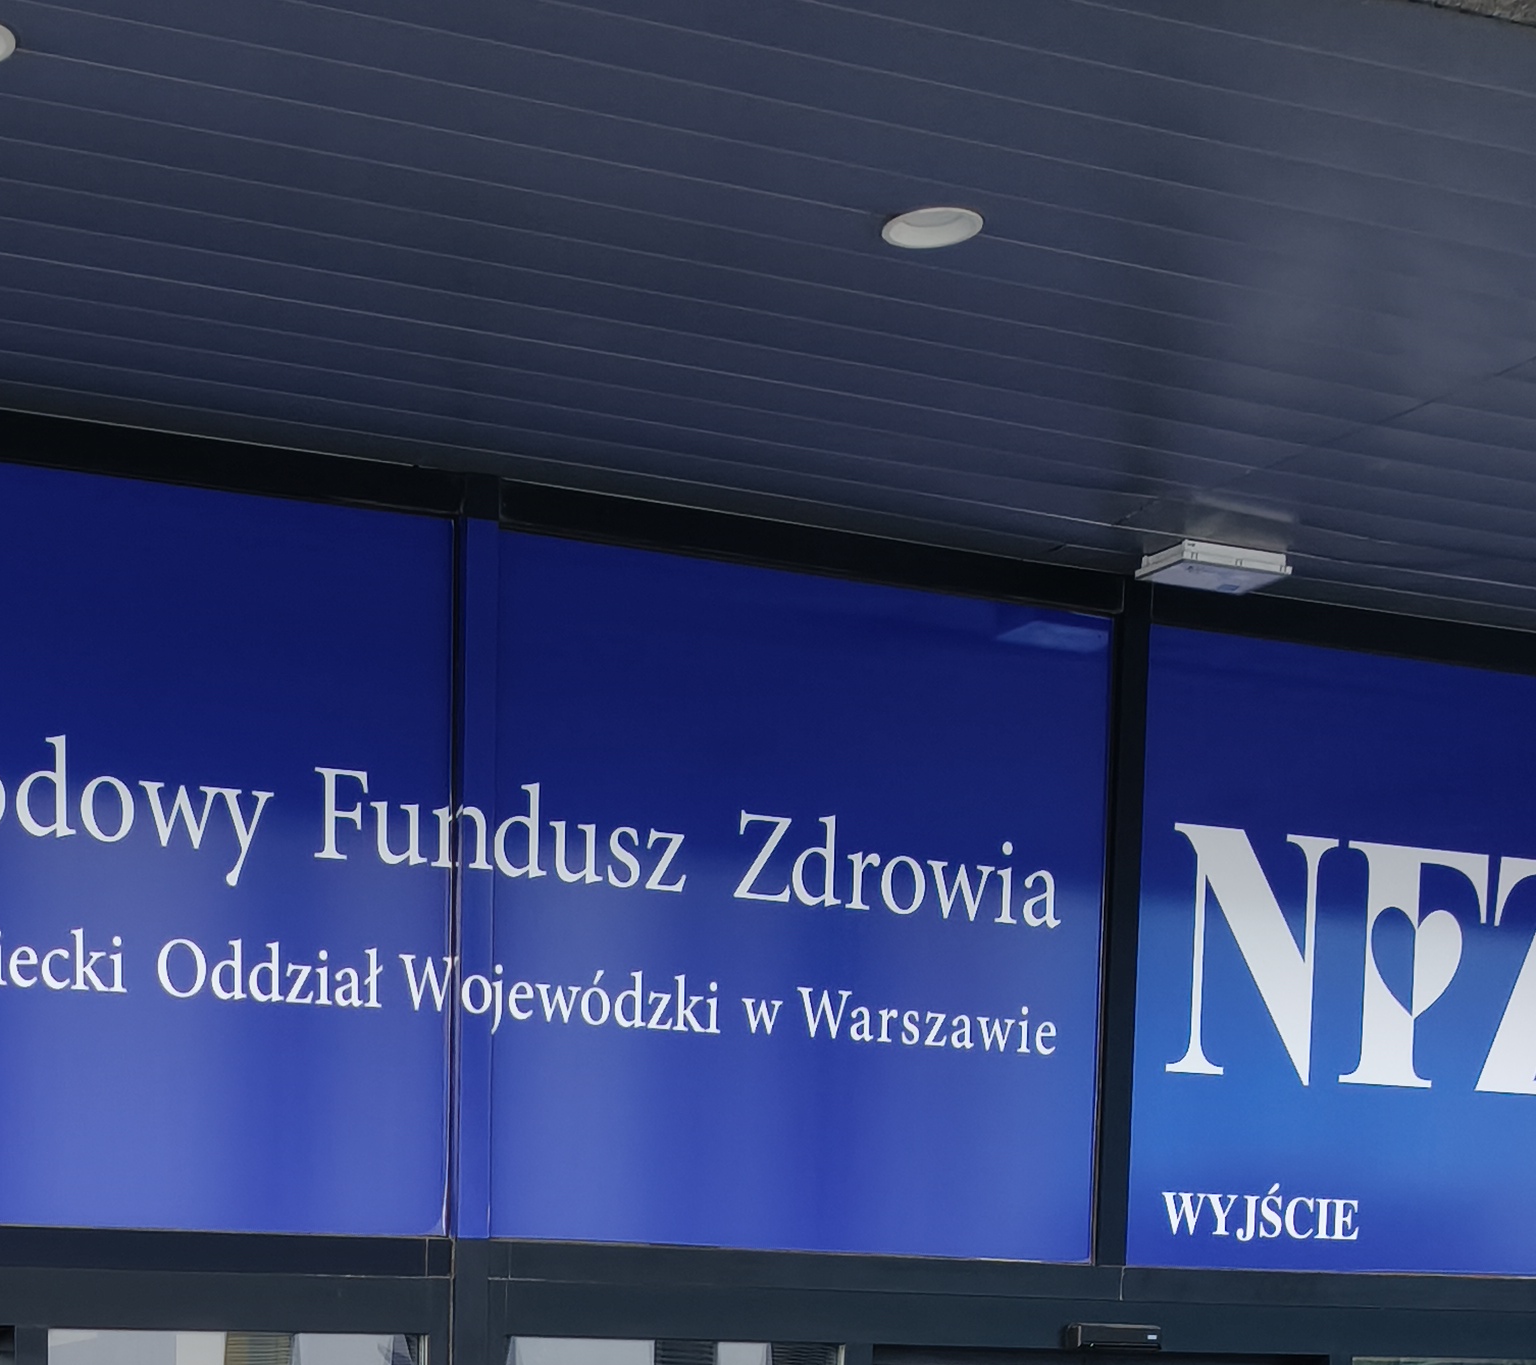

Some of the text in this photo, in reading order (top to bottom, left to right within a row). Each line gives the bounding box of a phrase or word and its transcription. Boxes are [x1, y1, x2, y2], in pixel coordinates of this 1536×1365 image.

[314, 767, 686, 893] Fundusz
[734, 810, 1061, 928] Zdrowia
[158, 939, 382, 1008] Oddział
[399, 953, 720, 1034] Wojewódzki
[742, 998, 783, 1034] w
[798, 987, 1057, 1055] Warszawie
[1162, 1183, 1359, 1241] WYJŚCIE
